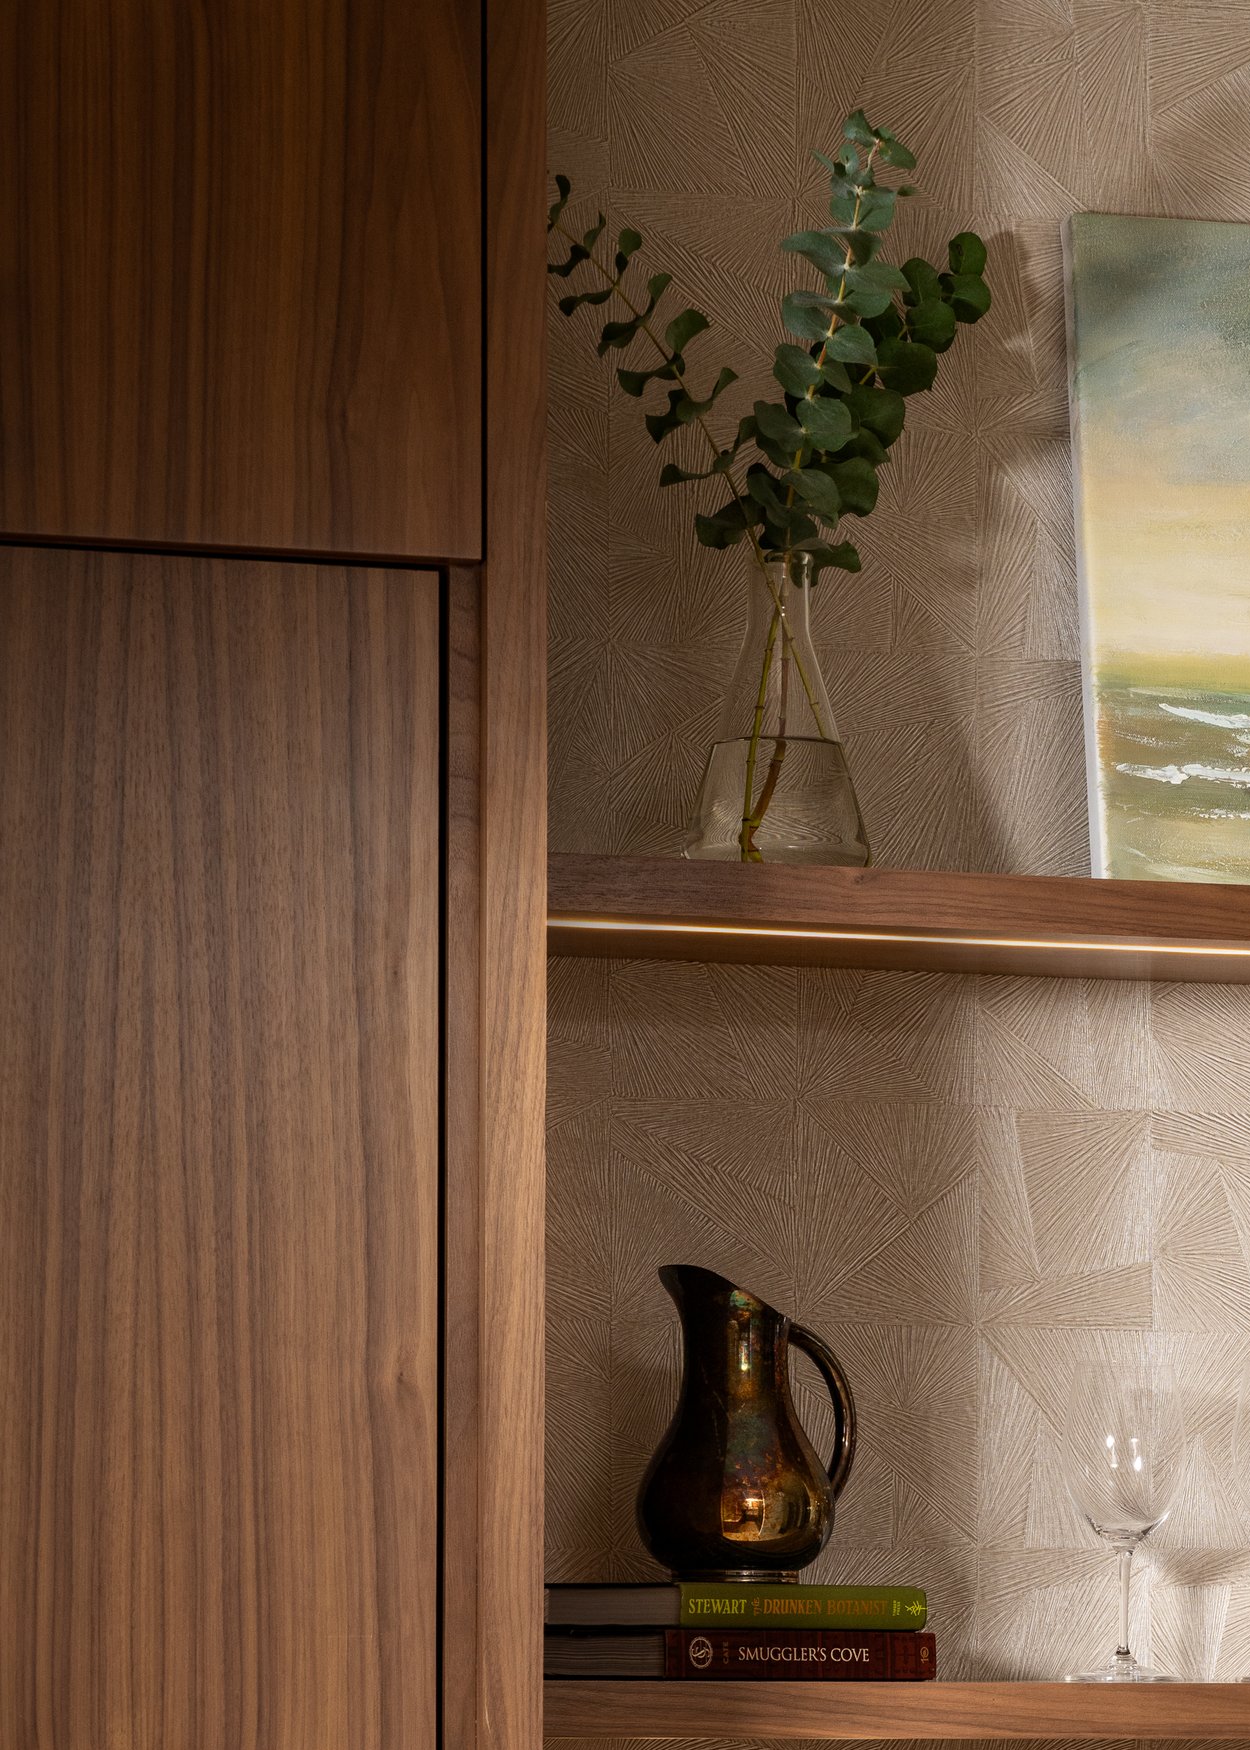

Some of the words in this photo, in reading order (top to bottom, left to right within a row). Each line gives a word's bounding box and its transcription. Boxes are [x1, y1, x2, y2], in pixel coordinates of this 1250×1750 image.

[688, 1599, 747, 1615] STEWART
[763, 1599, 822, 1615] DRUNKEN
[827, 1599, 889, 1616] BOTANIST
[738, 1646, 827, 1662] SMUGGLER'S
[830, 1648, 869, 1662] COVE
